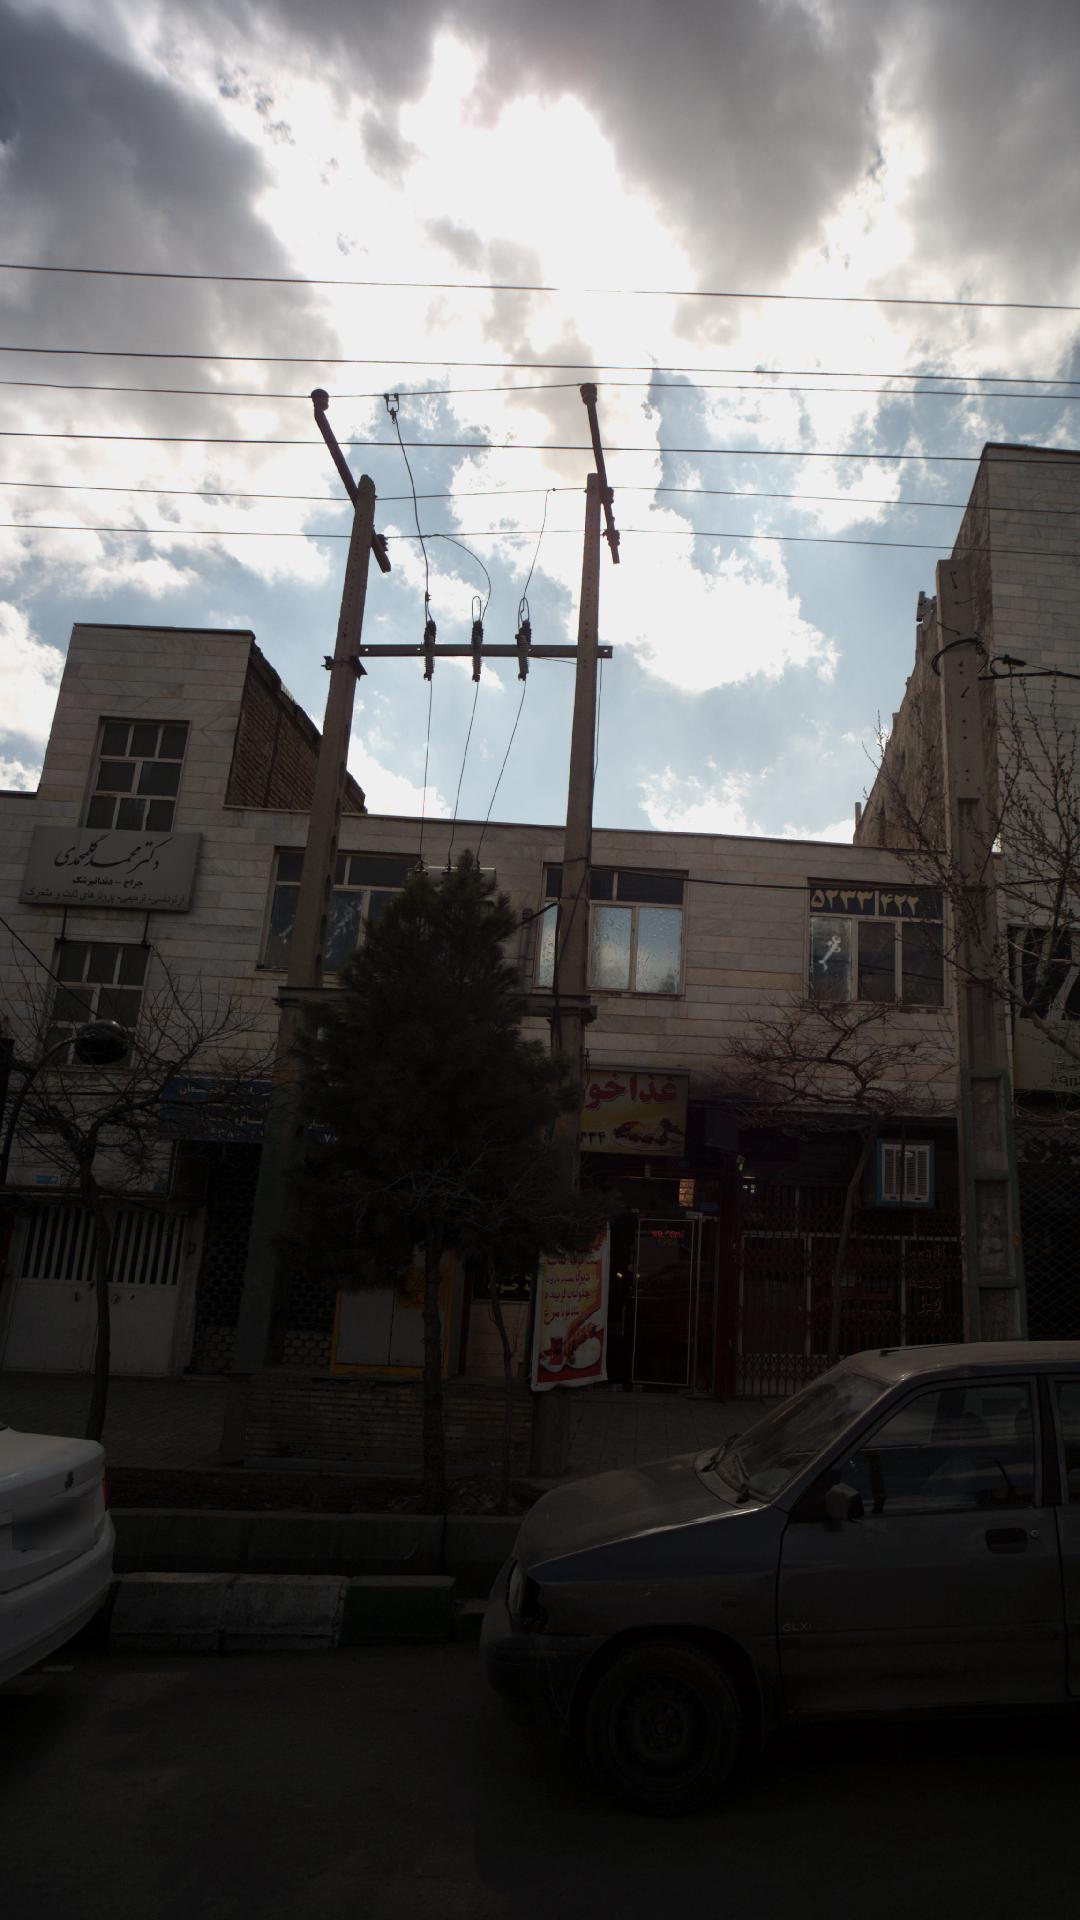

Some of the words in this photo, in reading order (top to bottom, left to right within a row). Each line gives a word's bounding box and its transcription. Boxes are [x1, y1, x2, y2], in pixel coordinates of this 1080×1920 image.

[84, 845, 141, 868] محمد
[126, 836, 173, 874] دکتر
[123, 879, 144, 890] جراح
